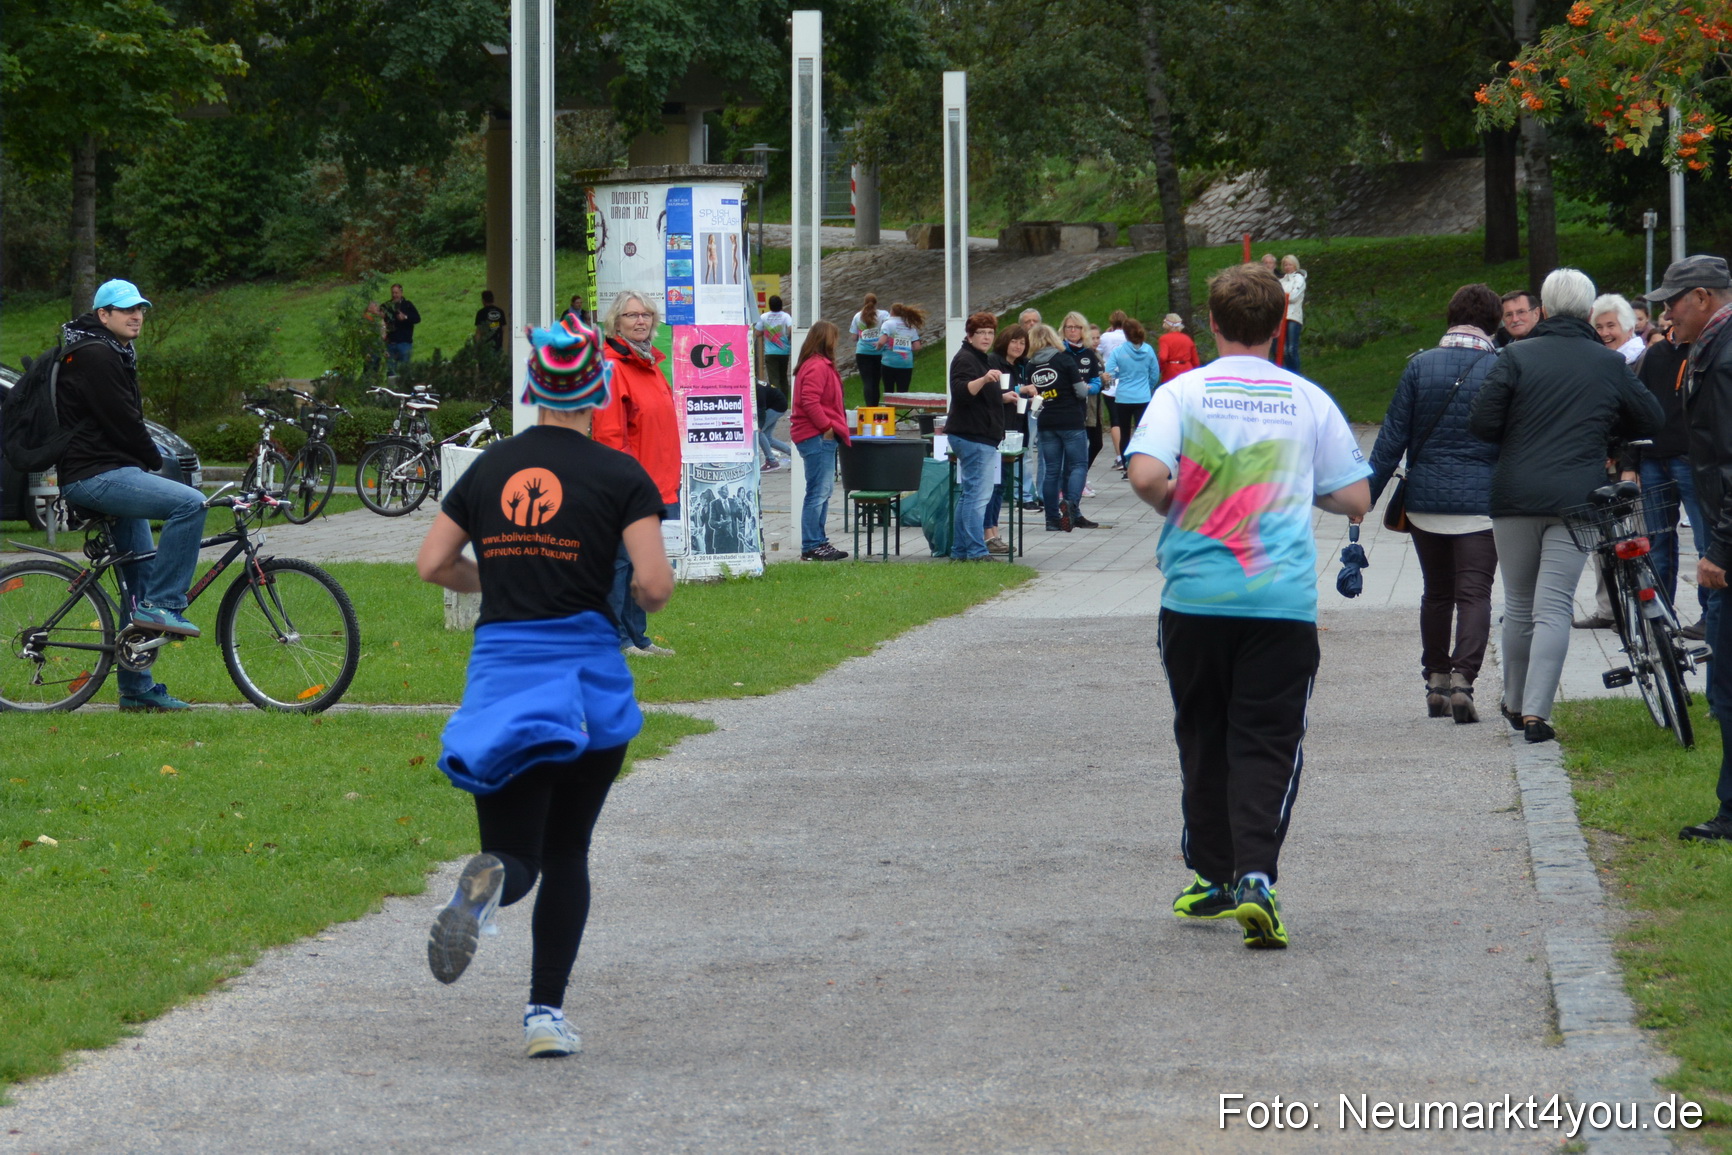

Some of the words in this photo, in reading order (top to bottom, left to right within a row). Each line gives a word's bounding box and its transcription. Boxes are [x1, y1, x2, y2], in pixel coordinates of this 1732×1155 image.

[634, 206, 649, 220] JAZZ
[699, 208, 730, 218] SPLISH
[711, 217, 740, 226] SPLASH
[690, 342, 735, 369] G6
[687, 399, 742, 411] Salsa-Abend
[1202, 396, 1297, 416] NeuerMarkt
[1262, 418, 1293, 426] genießen
[688, 432, 699, 442] Fr.
[700, 432, 708, 442] 2.
[709, 431, 724, 441] Okt.
[725, 430, 733, 441] 20
[734, 431, 744, 441] Uhr
[541, 547, 578, 561] ZUKUNFT
